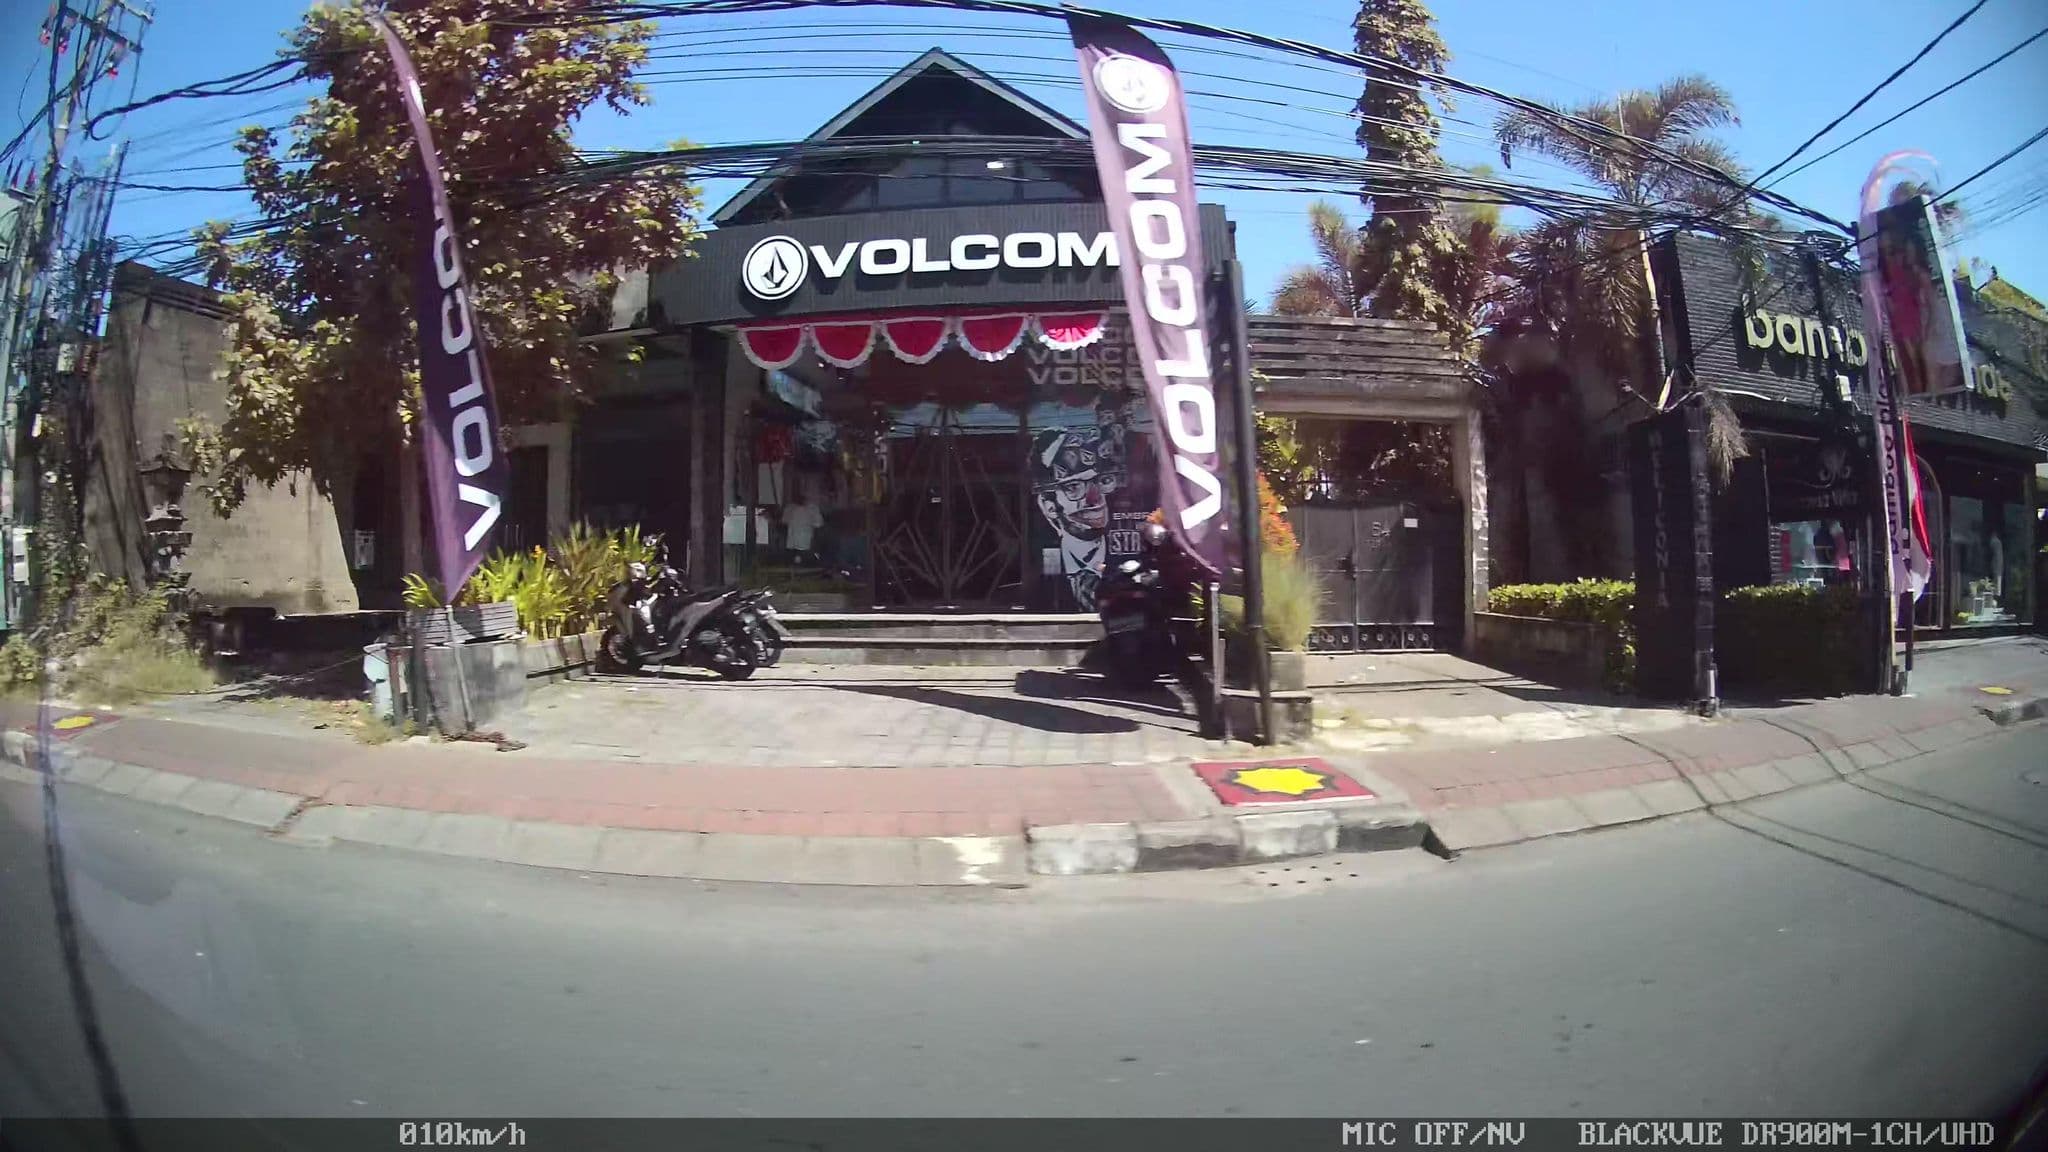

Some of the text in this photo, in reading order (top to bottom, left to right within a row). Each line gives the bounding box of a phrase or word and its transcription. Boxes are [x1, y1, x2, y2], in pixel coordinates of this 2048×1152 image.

[432, 208, 501, 551] VOLCO
[808, 232, 1121, 278] VOLCOM
[1118, 121, 1222, 530] VOLCOM
